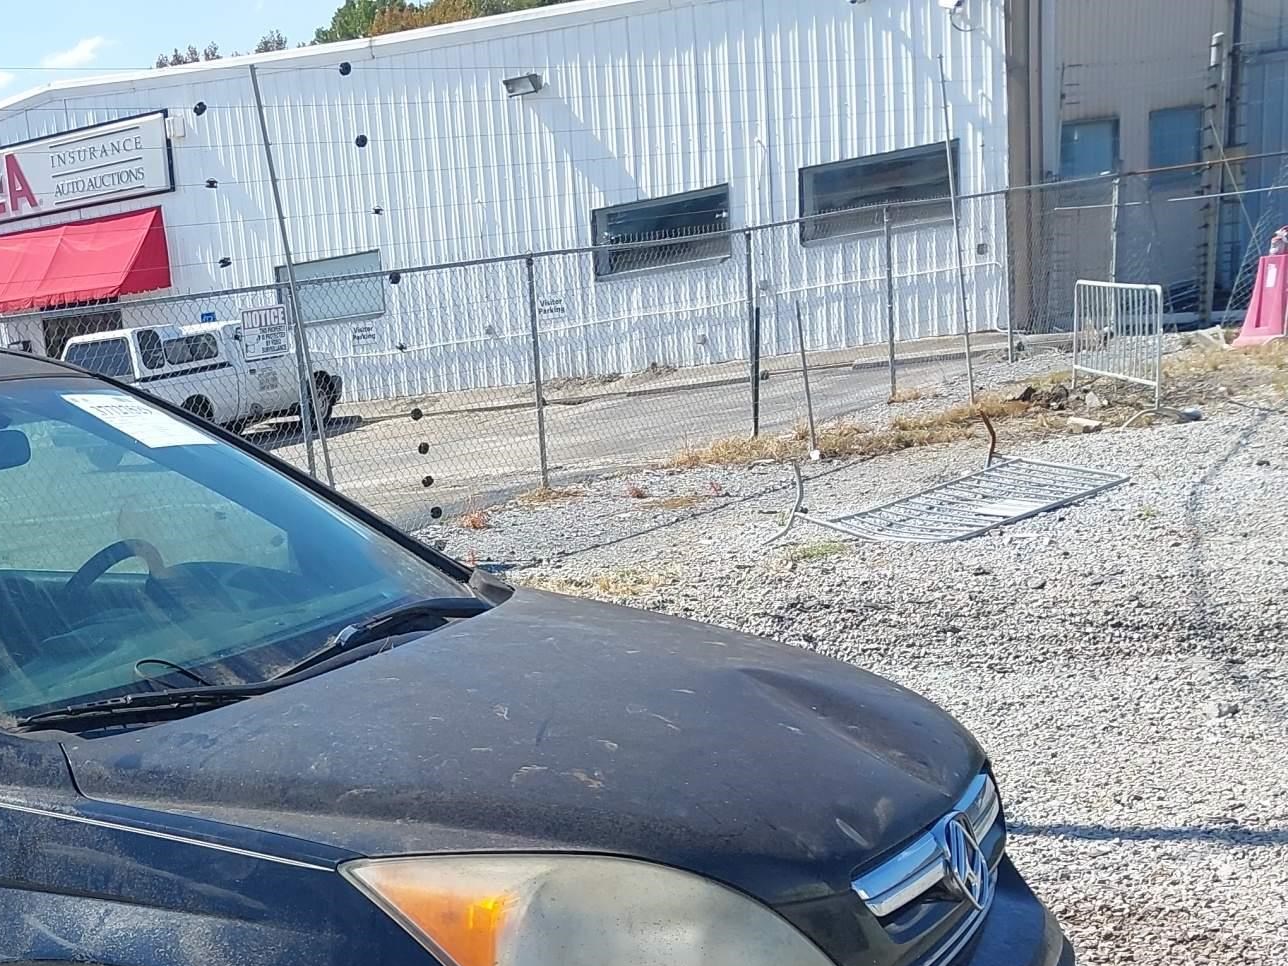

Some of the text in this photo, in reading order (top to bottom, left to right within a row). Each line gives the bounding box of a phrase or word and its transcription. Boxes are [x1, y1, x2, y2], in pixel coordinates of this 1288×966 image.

[50, 136, 143, 169] INSURANCE
[54, 167, 145, 198] AUTO AUCTIONS
[243, 307, 285, 329] NOTICE
